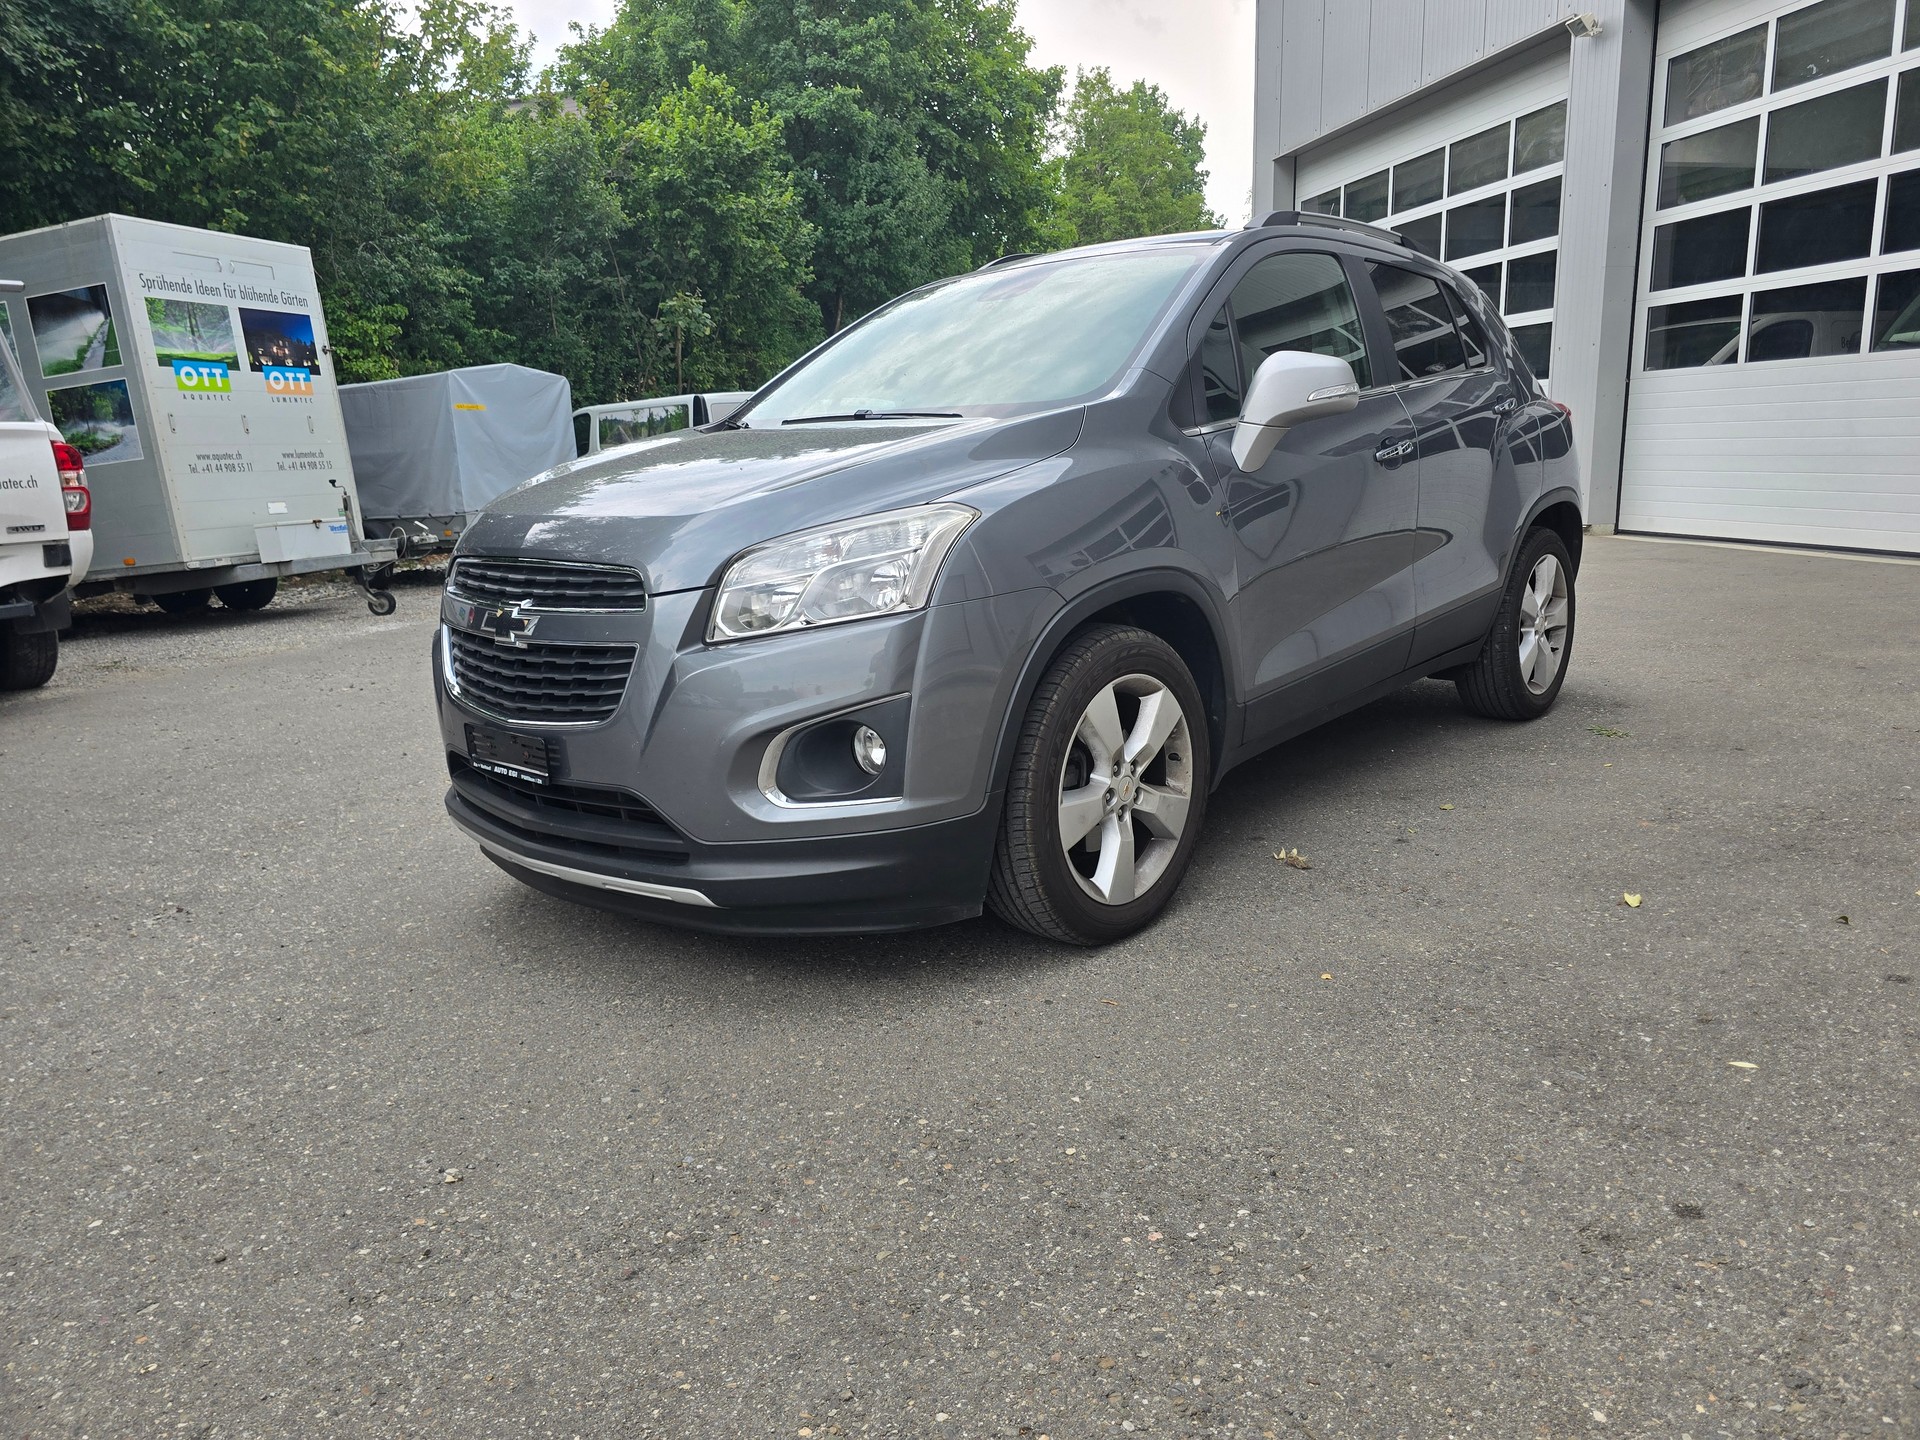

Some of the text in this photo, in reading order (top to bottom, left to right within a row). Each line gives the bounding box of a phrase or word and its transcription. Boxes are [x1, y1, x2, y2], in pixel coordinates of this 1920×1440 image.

[139, 273, 309, 308] Sprühende Ideen für blühende Gärten
[180, 366, 222, 387] OTT
[268, 371, 306, 391] OTT
[182, 393, 231, 401] AQUATEC
[271, 396, 313, 404] LUMENTEC
[196, 450, 243, 462] www.aquatec.ch
[281, 449, 325, 459] www.lumentec.ch
[188, 462, 253, 473] Tel. +41 44 908 55 11
[277, 461, 287, 471] Tel.
[288, 461, 298, 470] +41
[299, 461, 307, 470] 44
[307, 460, 318, 470] 908
[318, 460, 326, 470] 55
[0, 475, 38, 489] atec.ch
[494, 766, 507, 775] AUTO
